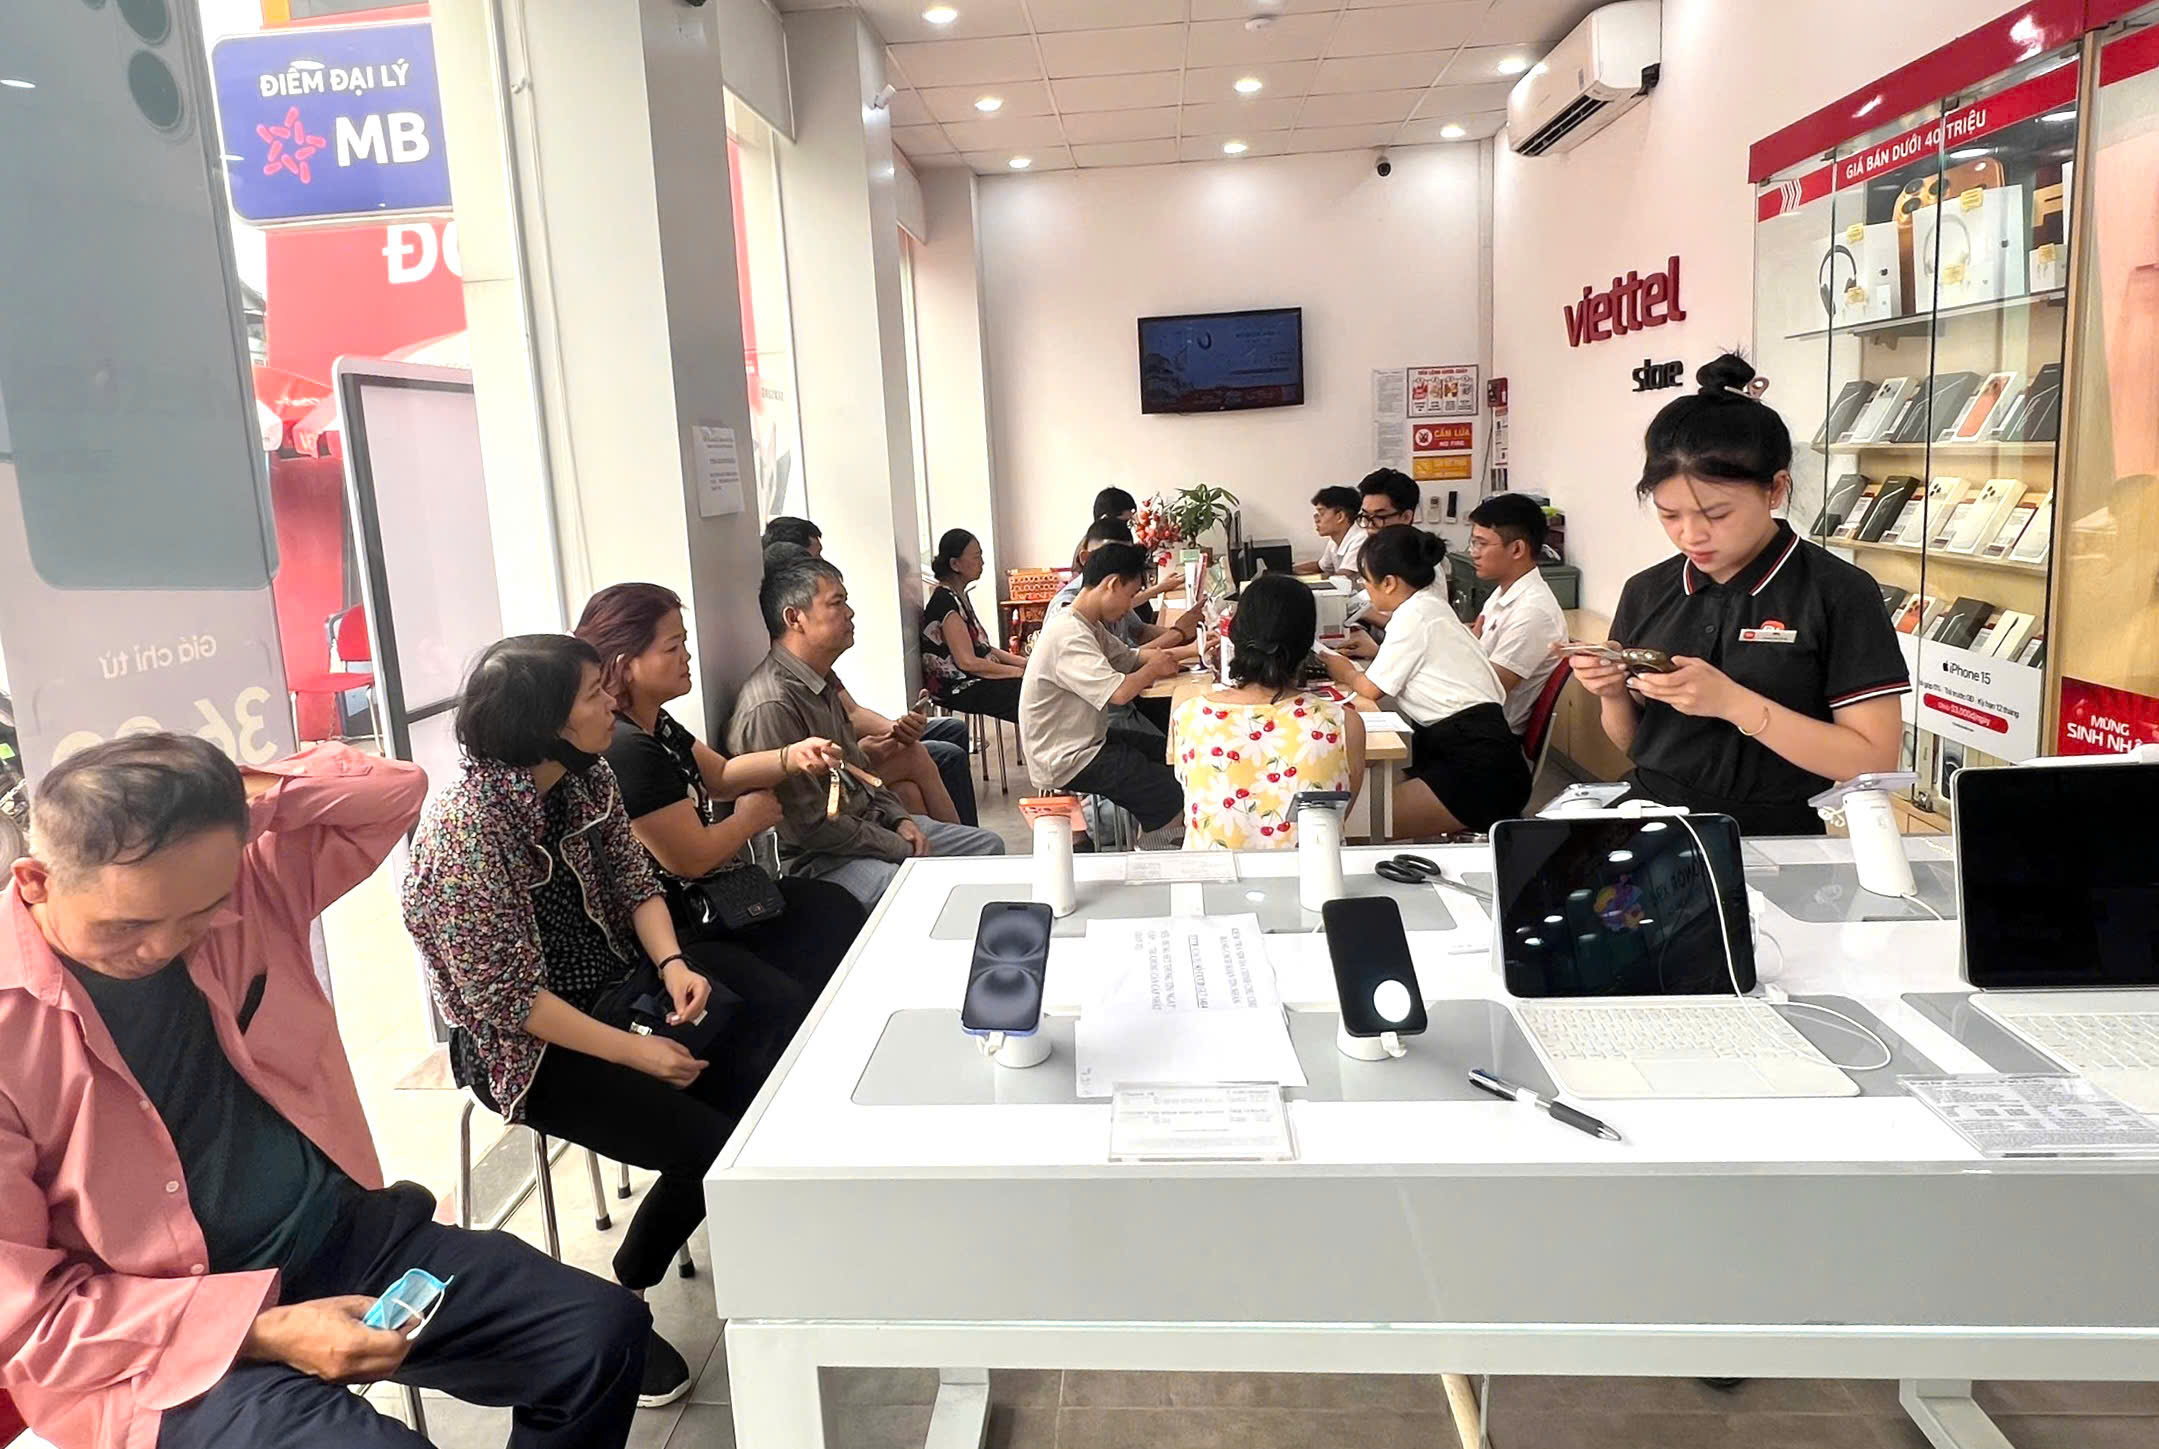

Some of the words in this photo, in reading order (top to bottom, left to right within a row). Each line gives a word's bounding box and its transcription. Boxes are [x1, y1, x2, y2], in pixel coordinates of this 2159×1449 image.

[330, 66, 374, 96] ĐẠI
[380, 58, 409, 88] LÝ
[335, 111, 430, 167] MB
[1846, 156, 1863, 179] GIÁ
[1866, 149, 1889, 172] BÁN
[1892, 133, 1921, 161] DƯỚI
[1924, 127, 1941, 147] 40
[1946, 109, 1986, 139] TRIỆU
[1563, 255, 1687, 347] viettel
[1632, 358, 1684, 392] store
[1949, 662, 1980, 682] iPhone
[1981, 671, 1991, 685] 15
[2067, 722, 2104, 746] SINH
